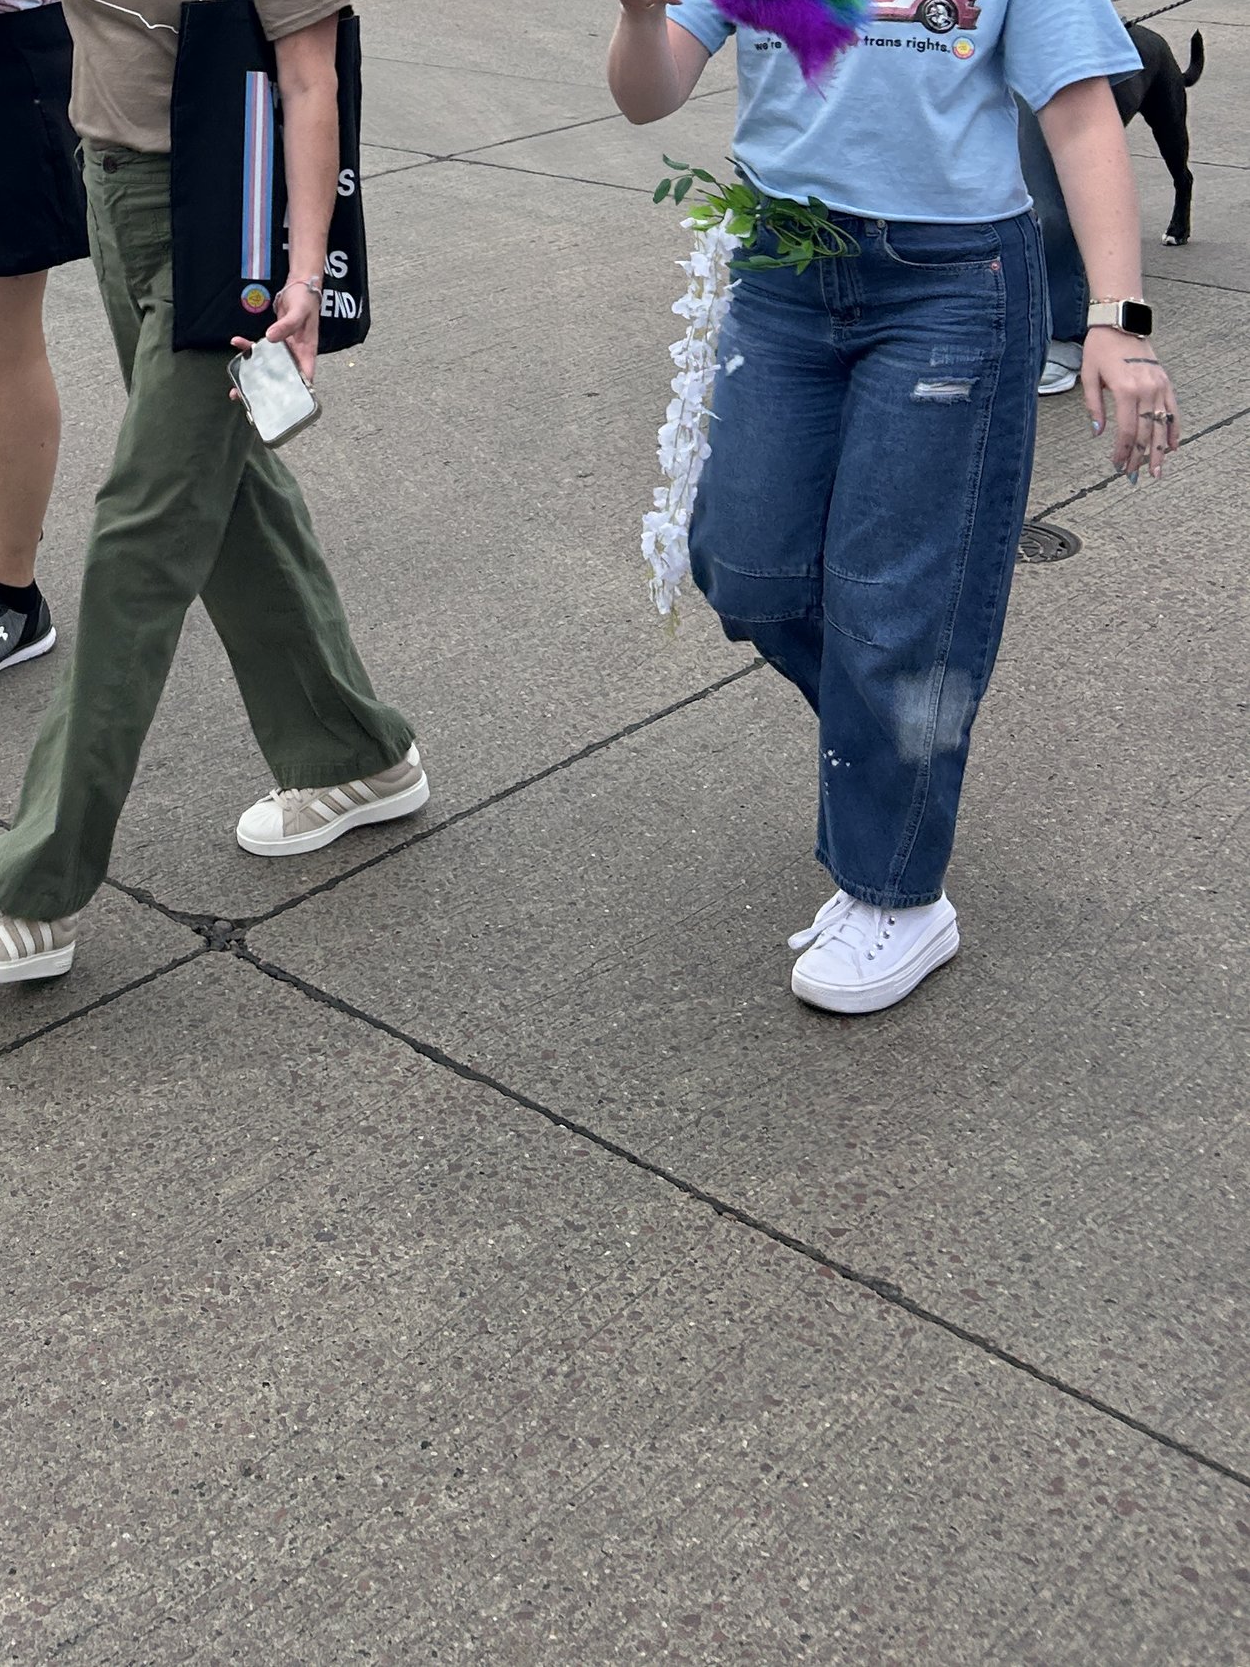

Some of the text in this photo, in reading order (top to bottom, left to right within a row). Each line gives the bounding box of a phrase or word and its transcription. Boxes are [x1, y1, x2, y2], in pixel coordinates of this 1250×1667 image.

[754, 34, 951, 54] we're trans rights.
